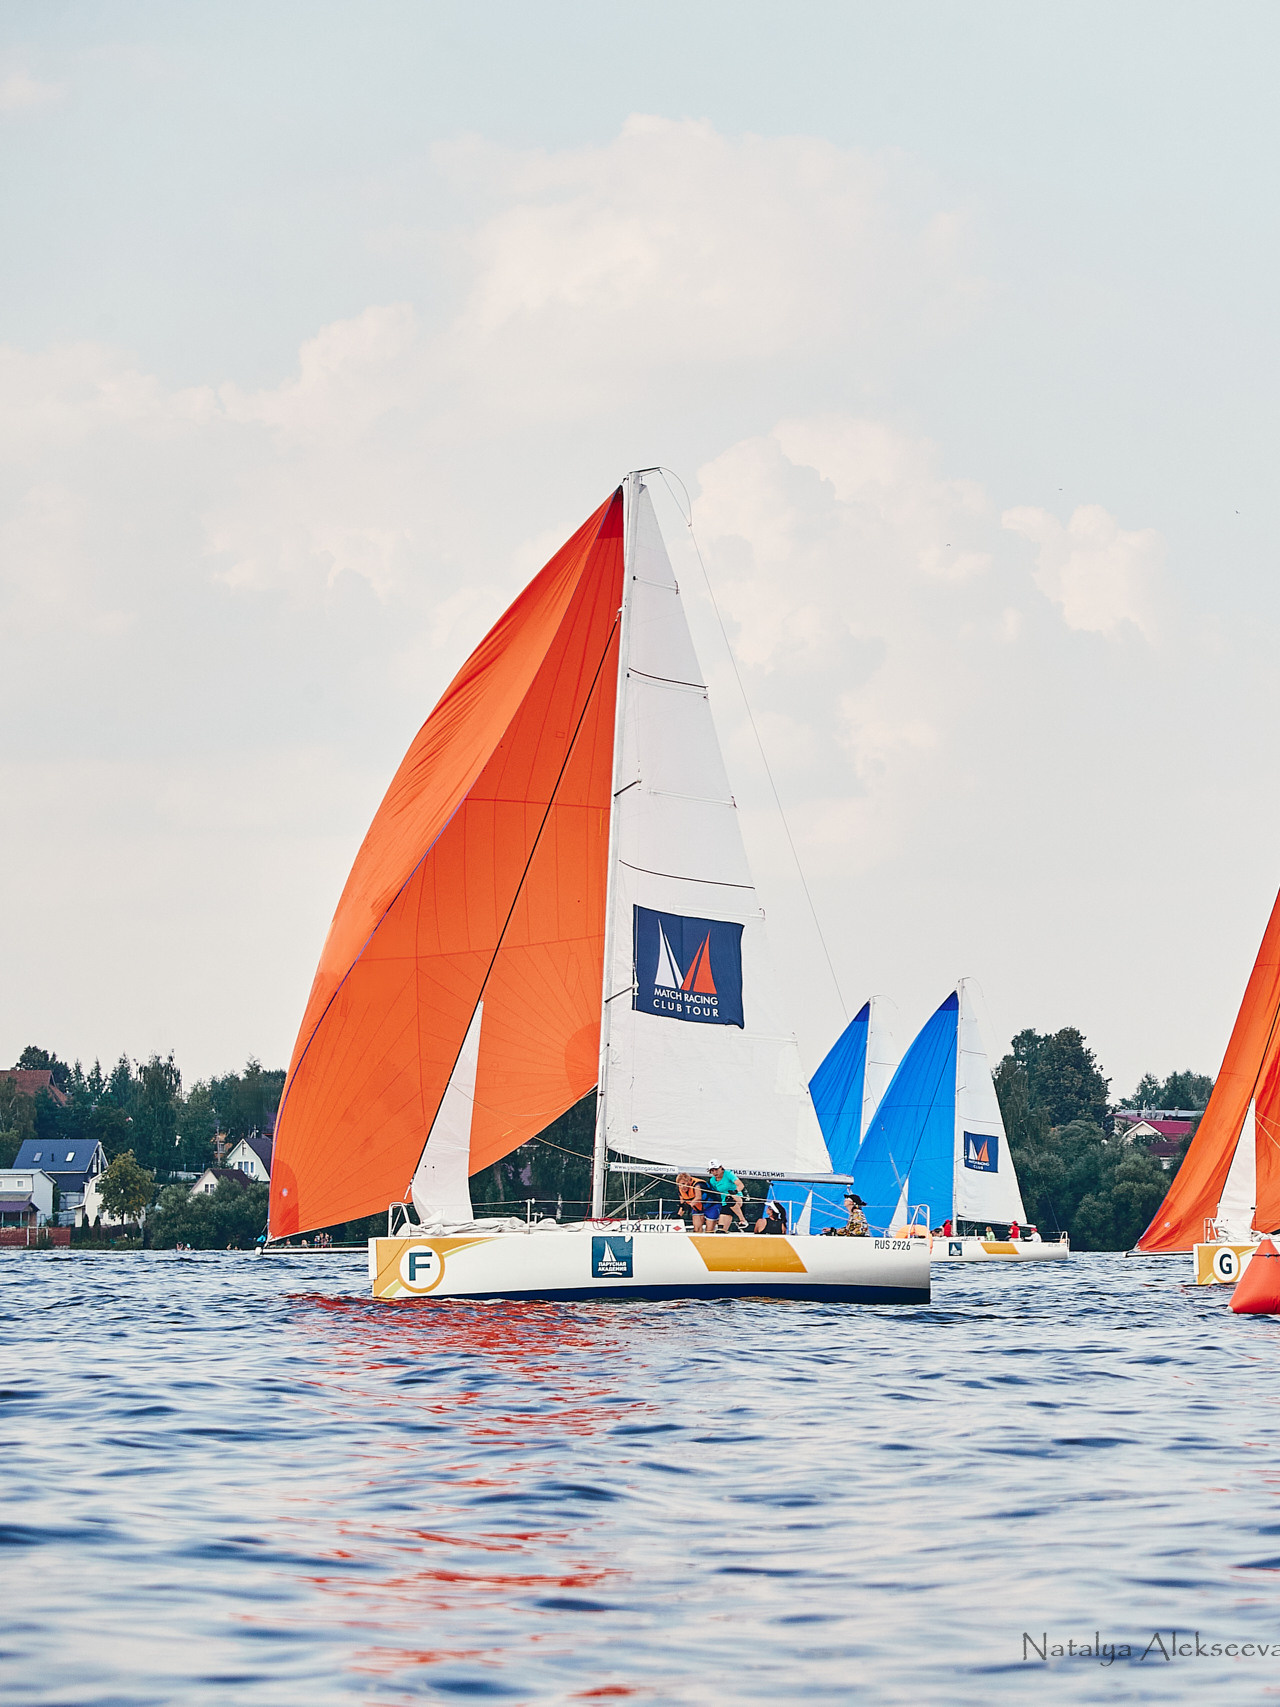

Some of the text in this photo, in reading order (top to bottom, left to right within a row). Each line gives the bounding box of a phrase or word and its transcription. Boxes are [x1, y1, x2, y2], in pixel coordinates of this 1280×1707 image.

[654, 988, 718, 1005] MATCH RACING
[653, 999, 719, 1017] CLUB TOUR
[620, 1224, 671, 1232] FOXTROT
[874, 1240, 911, 1250] RUS 2926
[409, 1252, 432, 1281] F
[1219, 1253, 1232, 1275] G
